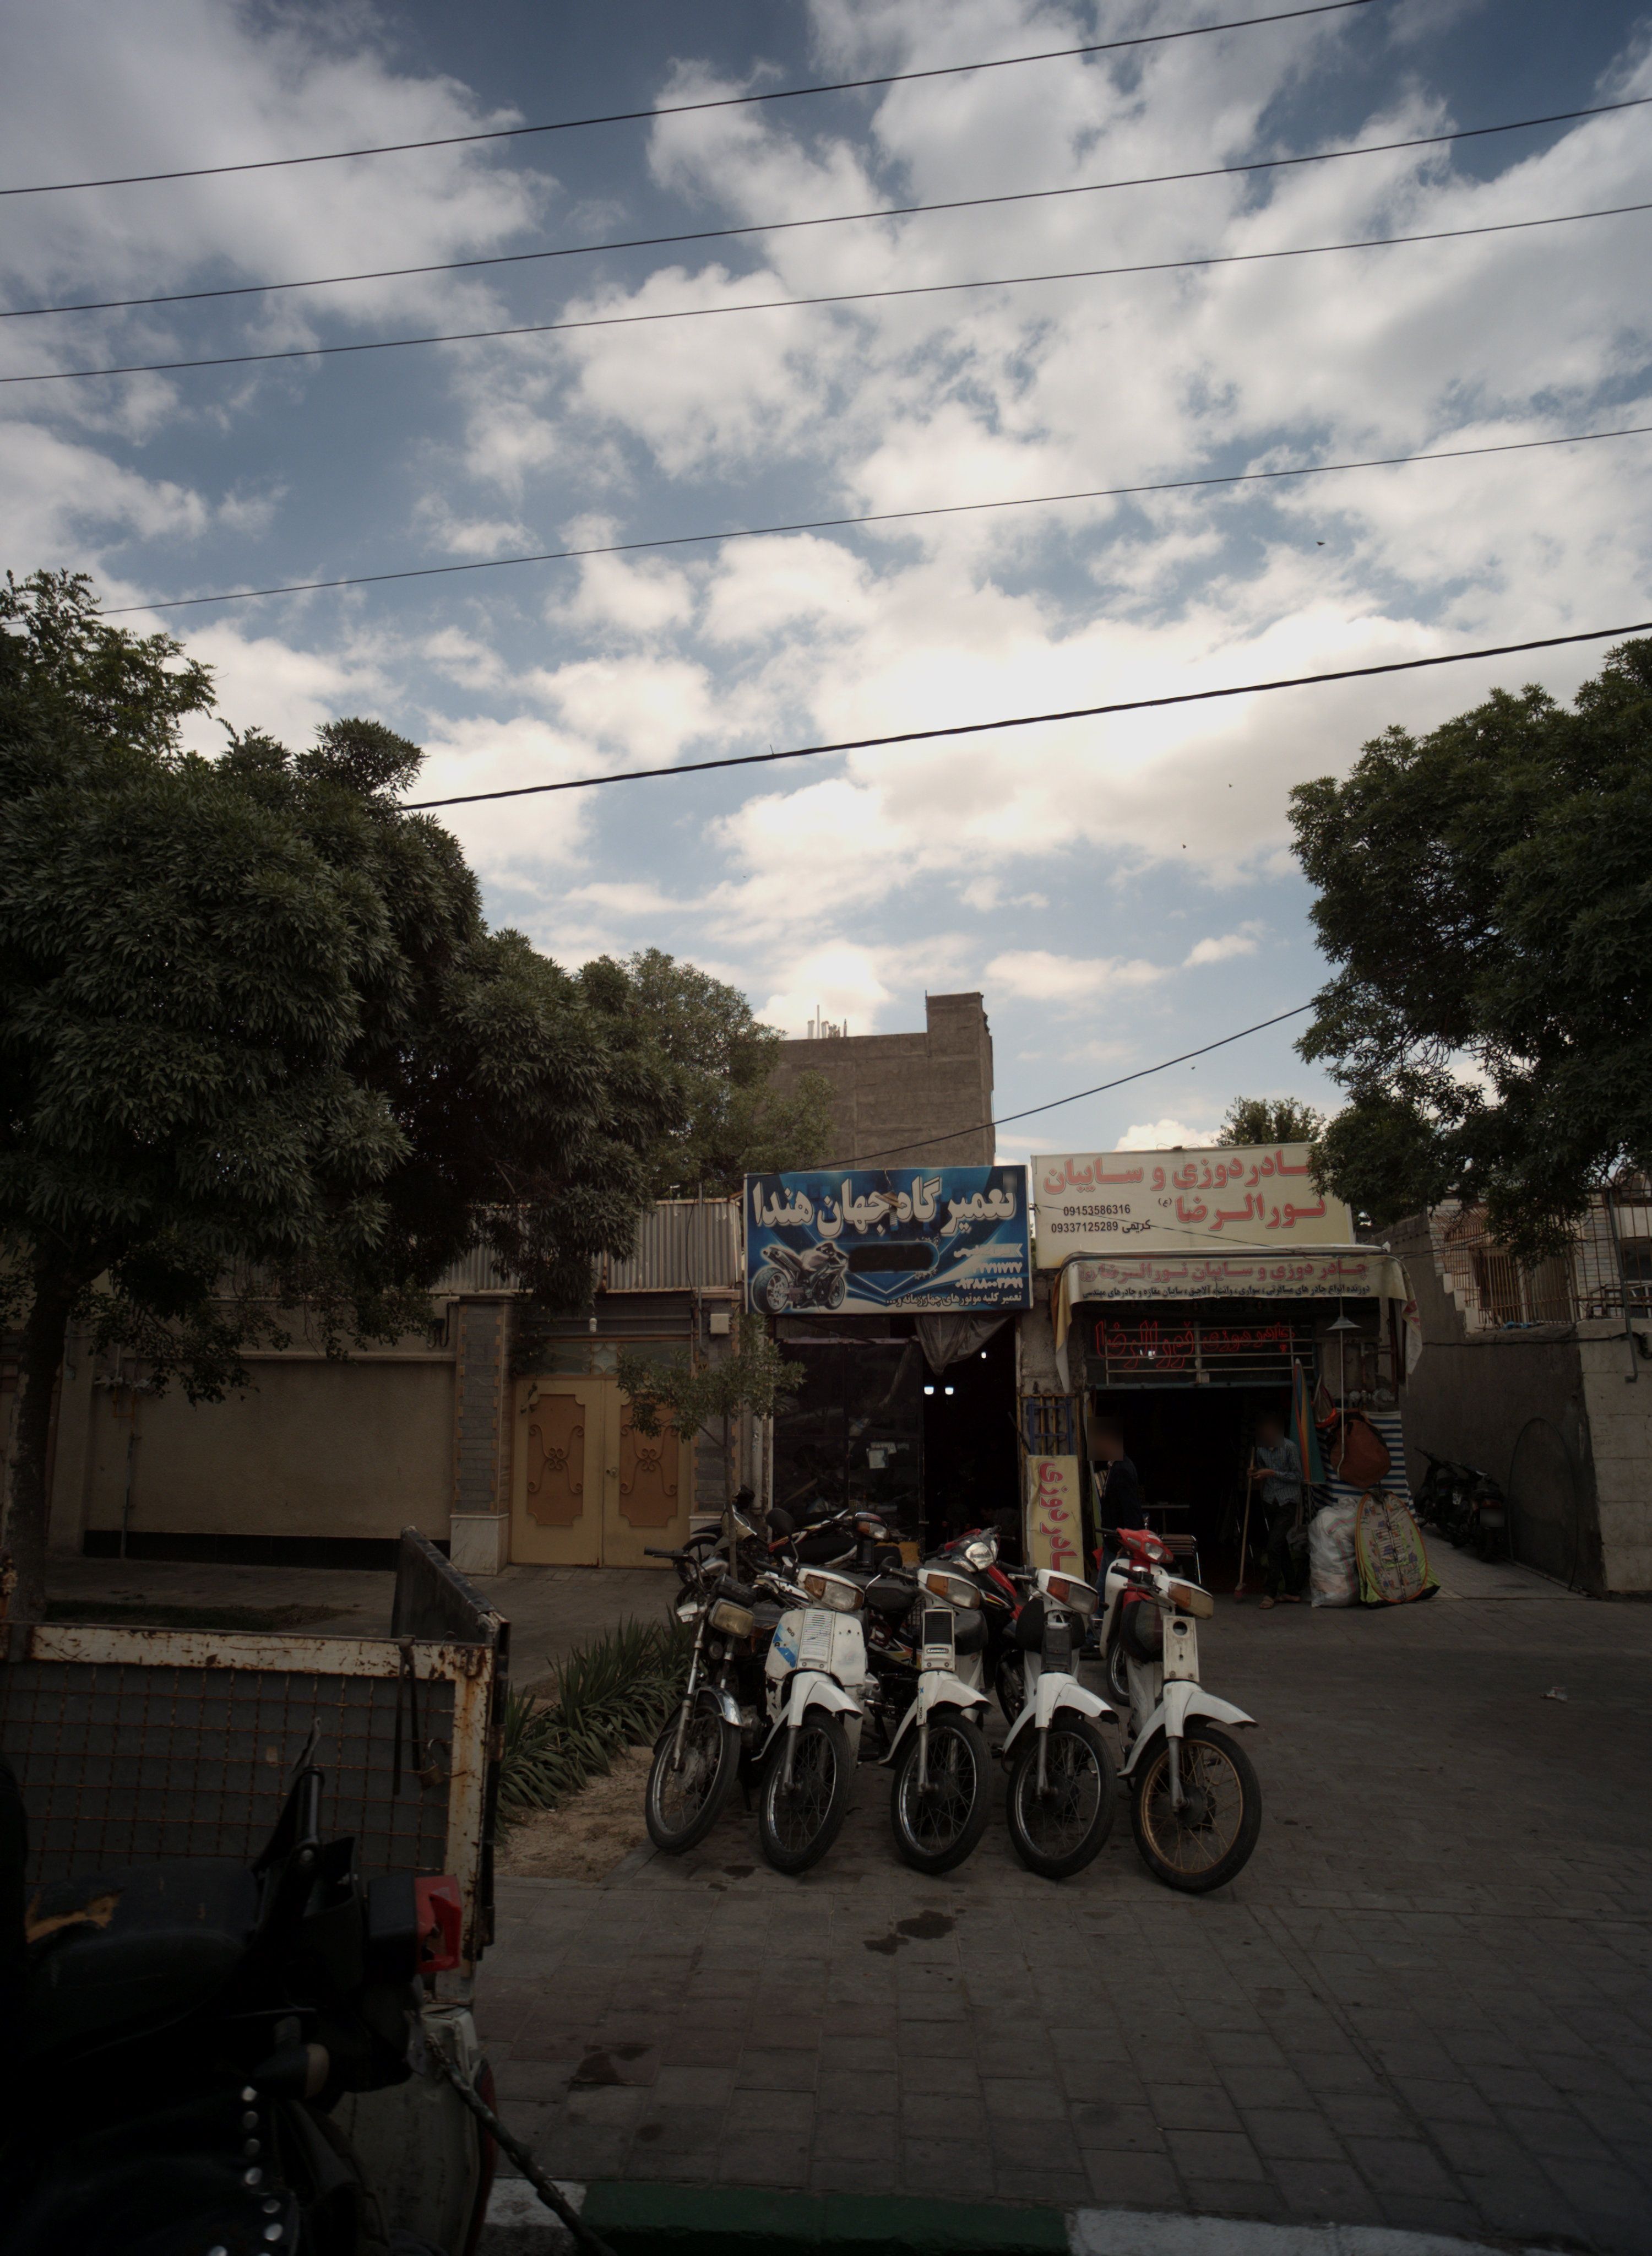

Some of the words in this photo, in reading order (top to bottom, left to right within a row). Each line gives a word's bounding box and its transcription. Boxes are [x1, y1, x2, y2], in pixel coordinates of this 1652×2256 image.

[1044, 1158, 1144, 1195] سایبان
[1245, 1149, 1314, 1186] ادر
[1150, 1166, 1166, 1191] و
[753, 1181, 814, 1227] هندا
[817, 1178, 890, 1237] جهان
[1063, 1204, 1131, 1216] 09153586316
[1051, 1221, 1118, 1233] 09337125289
[1122, 1219, 1151, 1233] کریمی
[1191, 1261, 1253, 1282] سایبان
[1257, 1267, 1266, 1281] و
[1270, 1263, 1314, 1281] دوزی
[1318, 1258, 1368, 1281] چادر
[982, 1292, 999, 1304] کلیه
[1001, 1292, 1022, 1305] تعمیر
[1040, 1522, 1078, 1571] ادر
